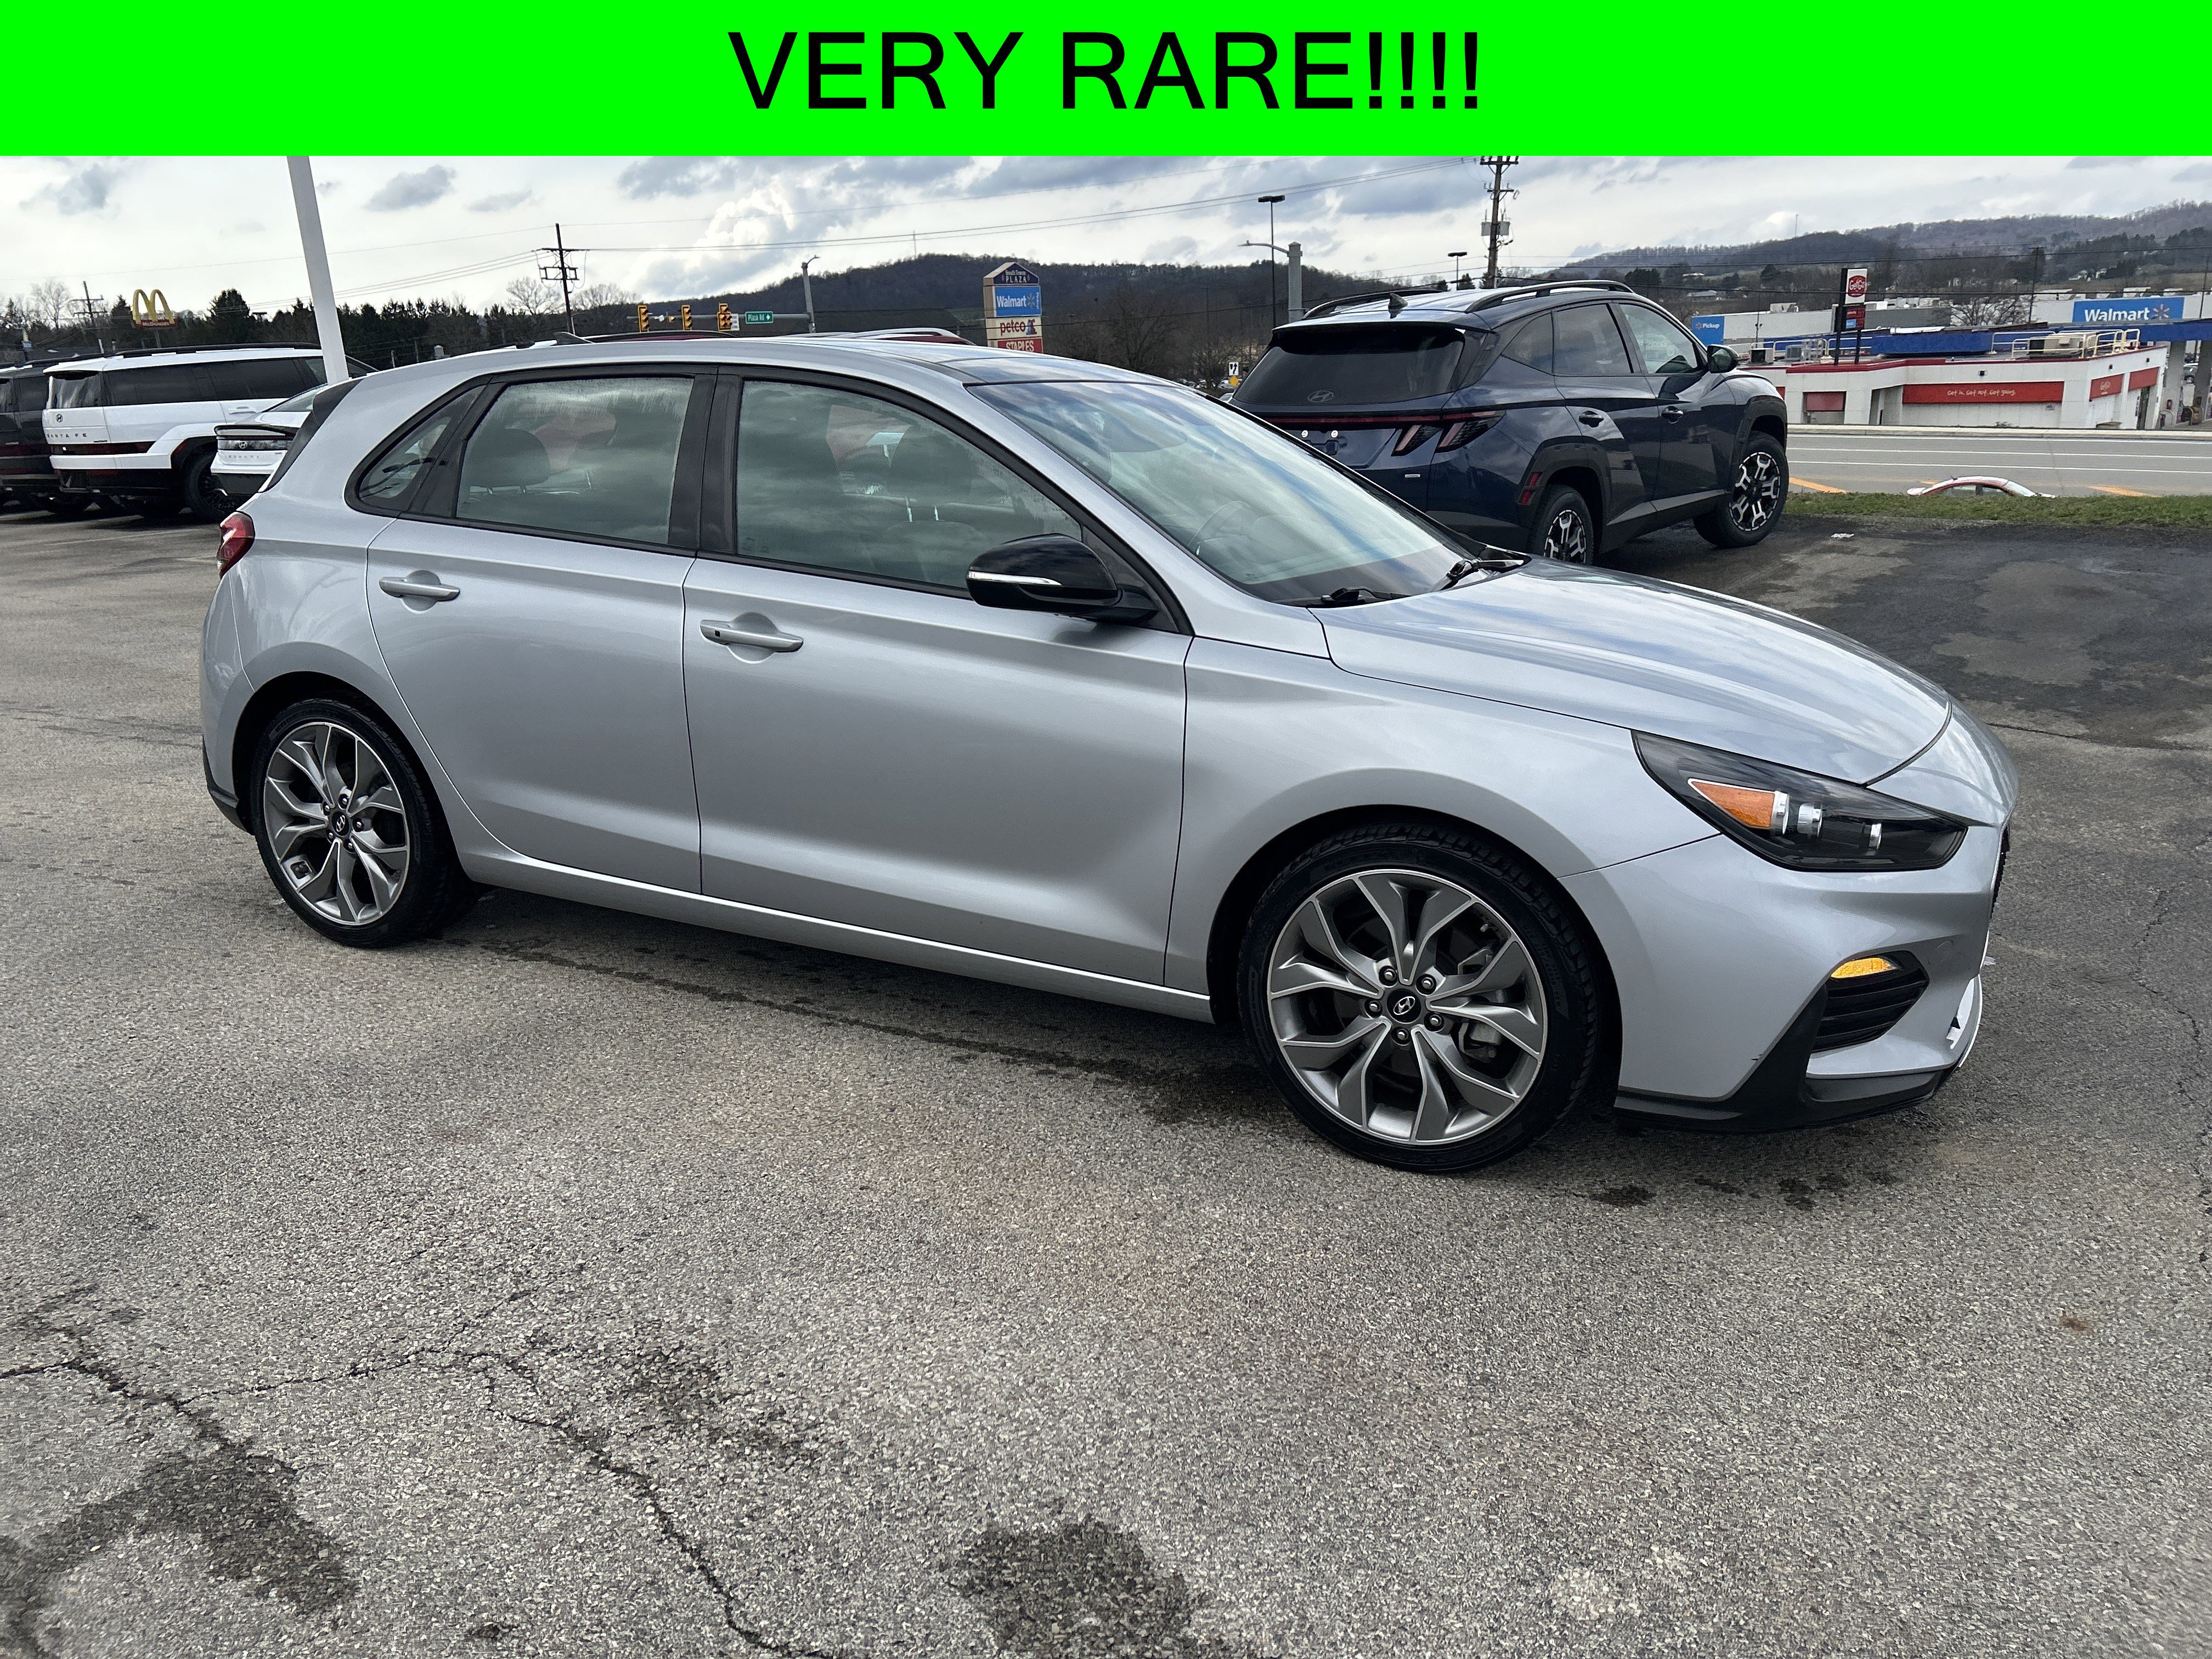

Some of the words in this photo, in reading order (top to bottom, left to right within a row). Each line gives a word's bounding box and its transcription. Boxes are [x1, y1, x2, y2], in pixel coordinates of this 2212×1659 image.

[996, 296, 1026, 307] Walmart
[2085, 307, 2149, 322] Walmart
[1000, 320, 1026, 336] petco
